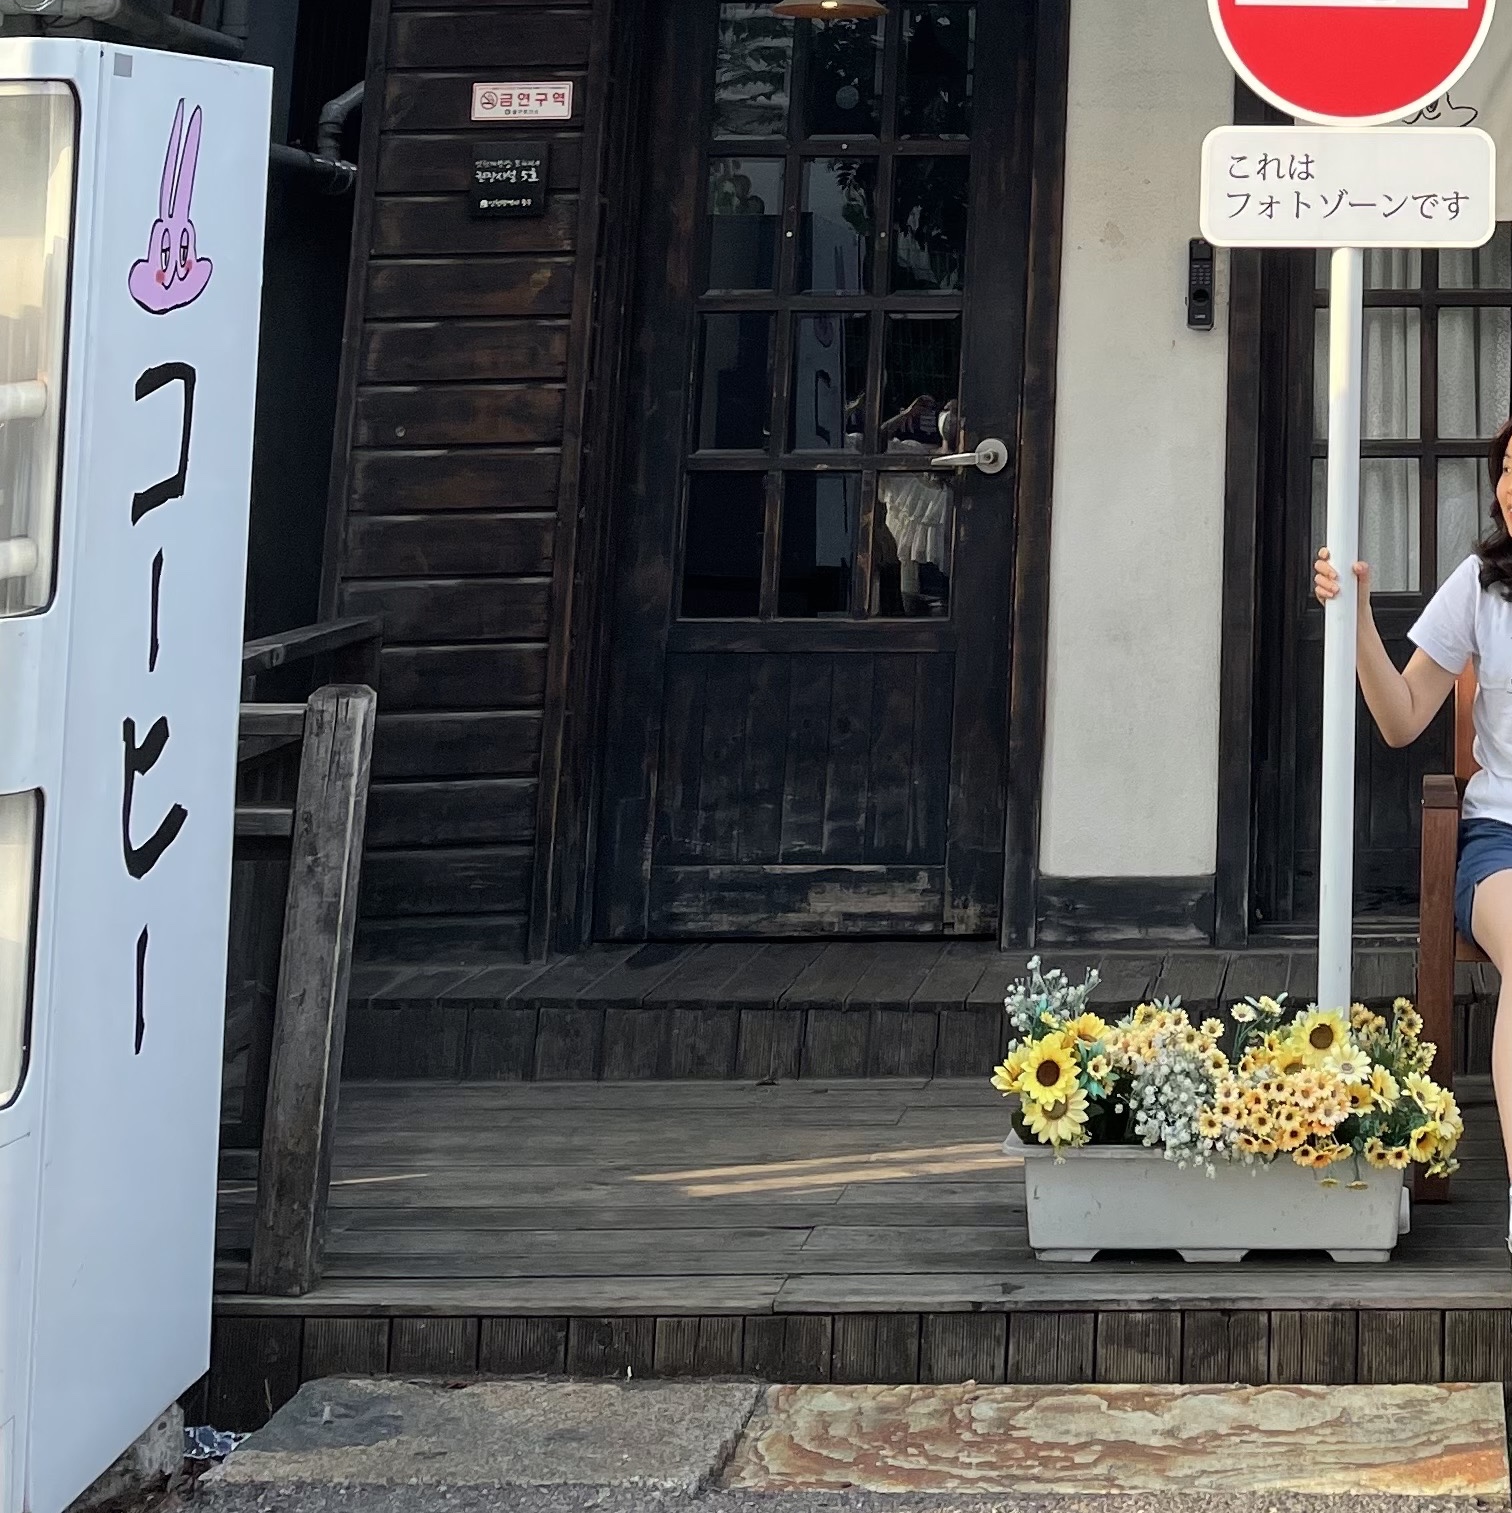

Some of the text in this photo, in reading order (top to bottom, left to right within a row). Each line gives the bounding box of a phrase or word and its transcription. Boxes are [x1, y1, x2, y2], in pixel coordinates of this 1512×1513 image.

[500, 92, 565, 107] 금연구역
[1228, 152, 1315, 181] これは
[1226, 188, 1470, 221] フォトゾーンです
[122, 361, 197, 1056] コーヒー
